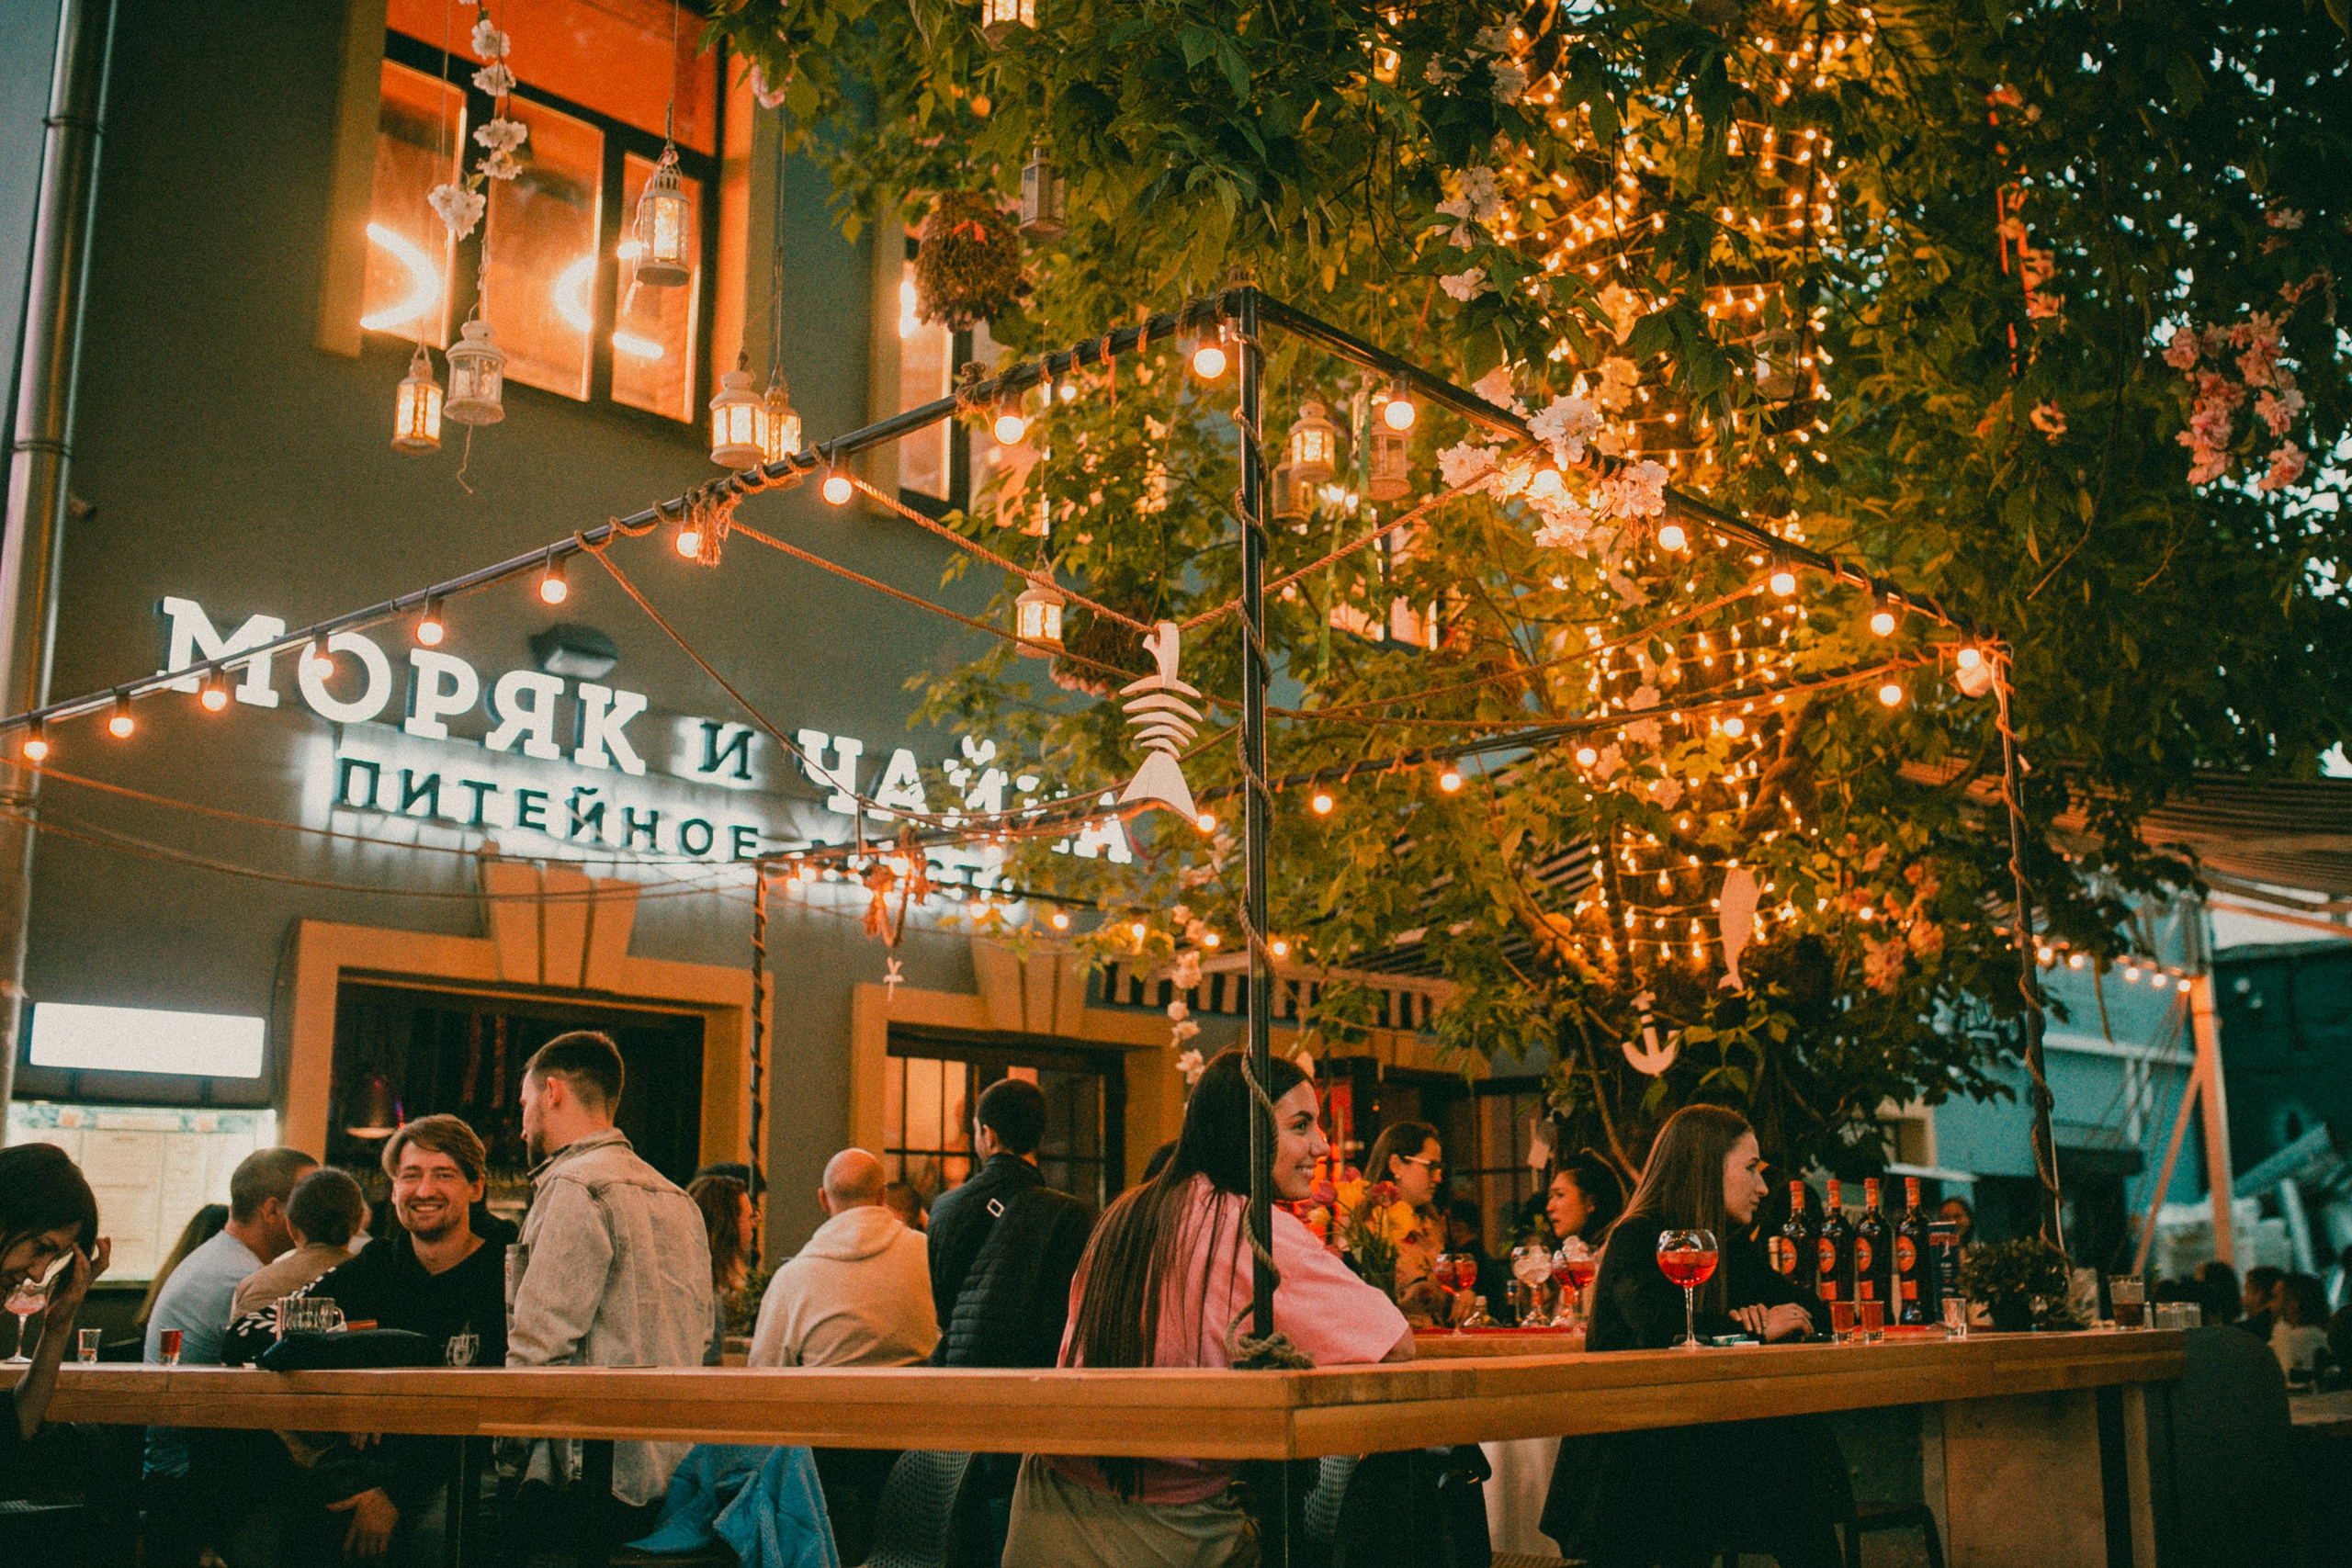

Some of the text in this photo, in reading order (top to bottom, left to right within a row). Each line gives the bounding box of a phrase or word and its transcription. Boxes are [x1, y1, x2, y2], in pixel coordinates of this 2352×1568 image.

[162, 595, 1133, 864] МОРЯК И ЧАЙА
[336, 756, 759, 860] ПИТЕЙНОЕ
